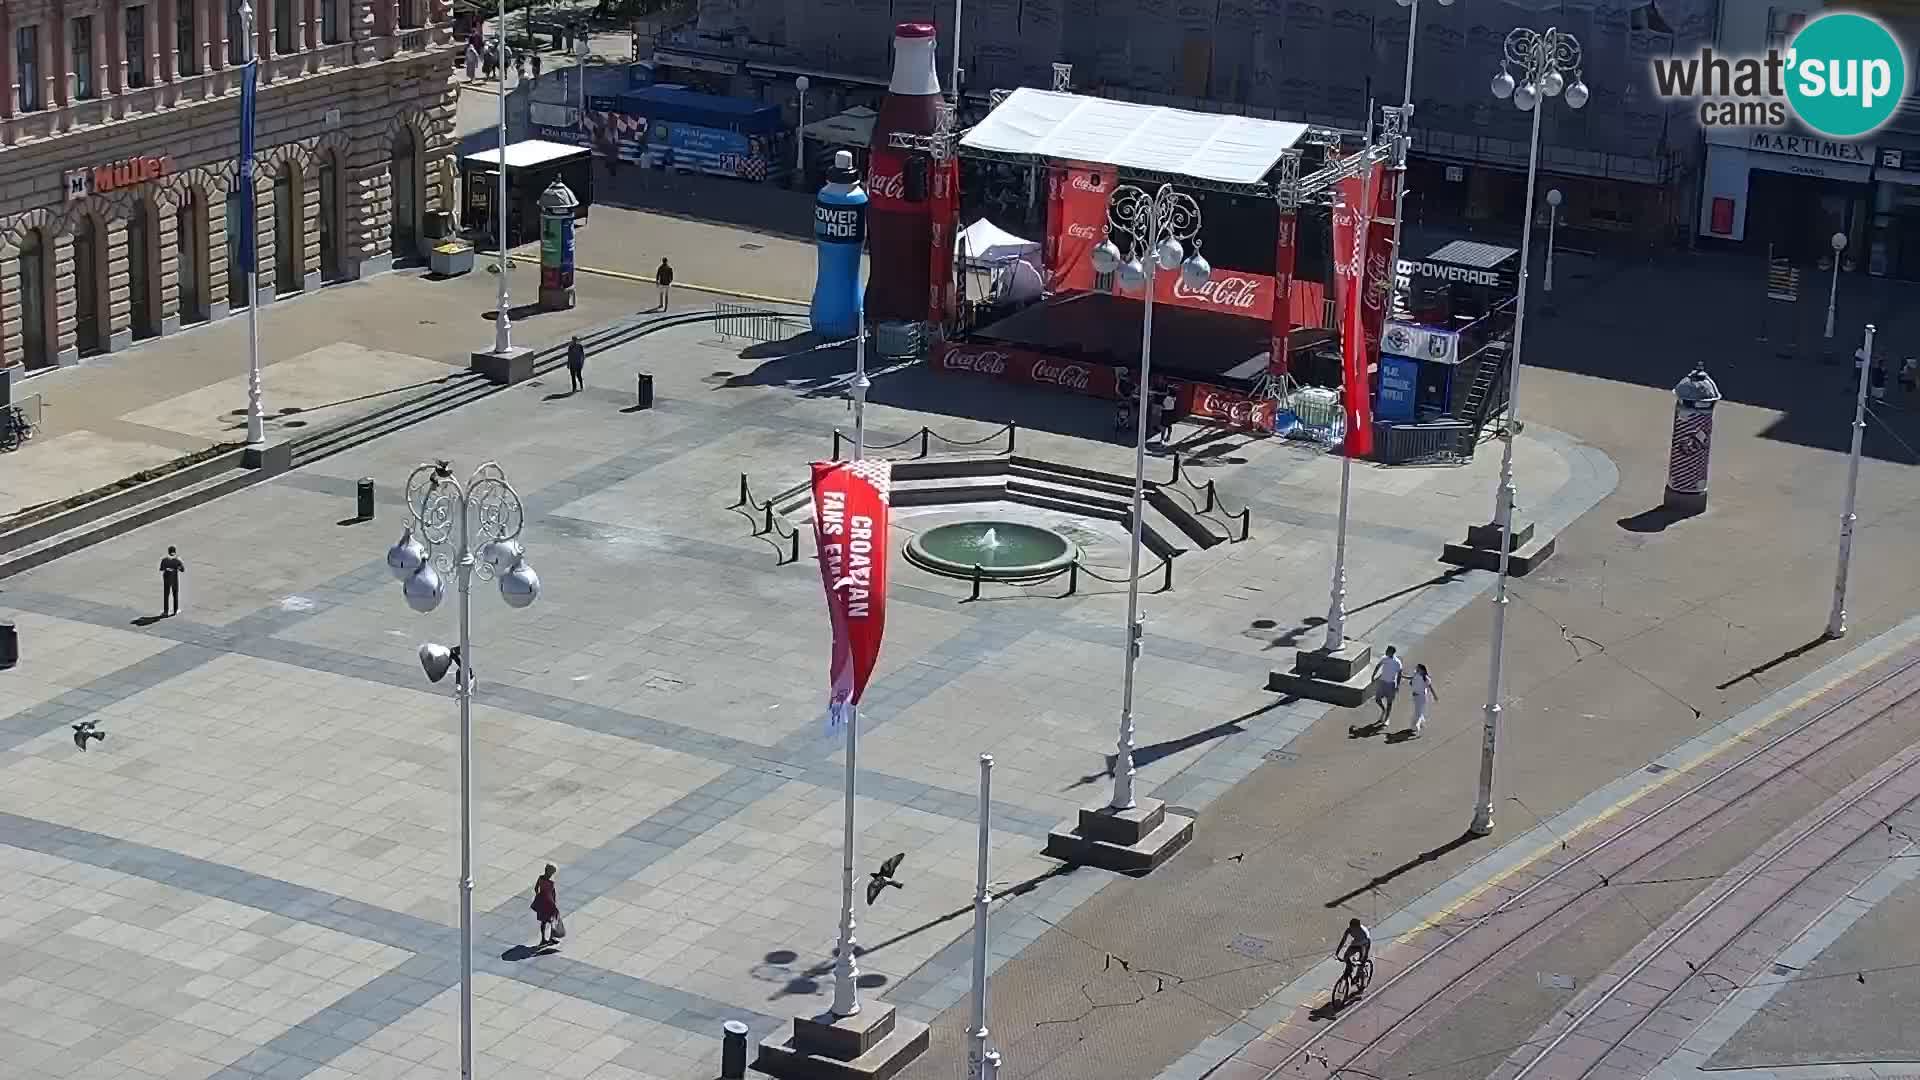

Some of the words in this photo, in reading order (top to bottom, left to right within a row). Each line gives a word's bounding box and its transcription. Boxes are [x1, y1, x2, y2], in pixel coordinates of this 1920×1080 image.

[1754, 133, 1865, 161] MARTIMEX
[95, 156, 171, 192] Müller
[815, 206, 858, 224] OWER
[827, 223, 857, 237] ADE
[1411, 261, 1500, 287] POWERADE
[822, 491, 845, 535] FANS
